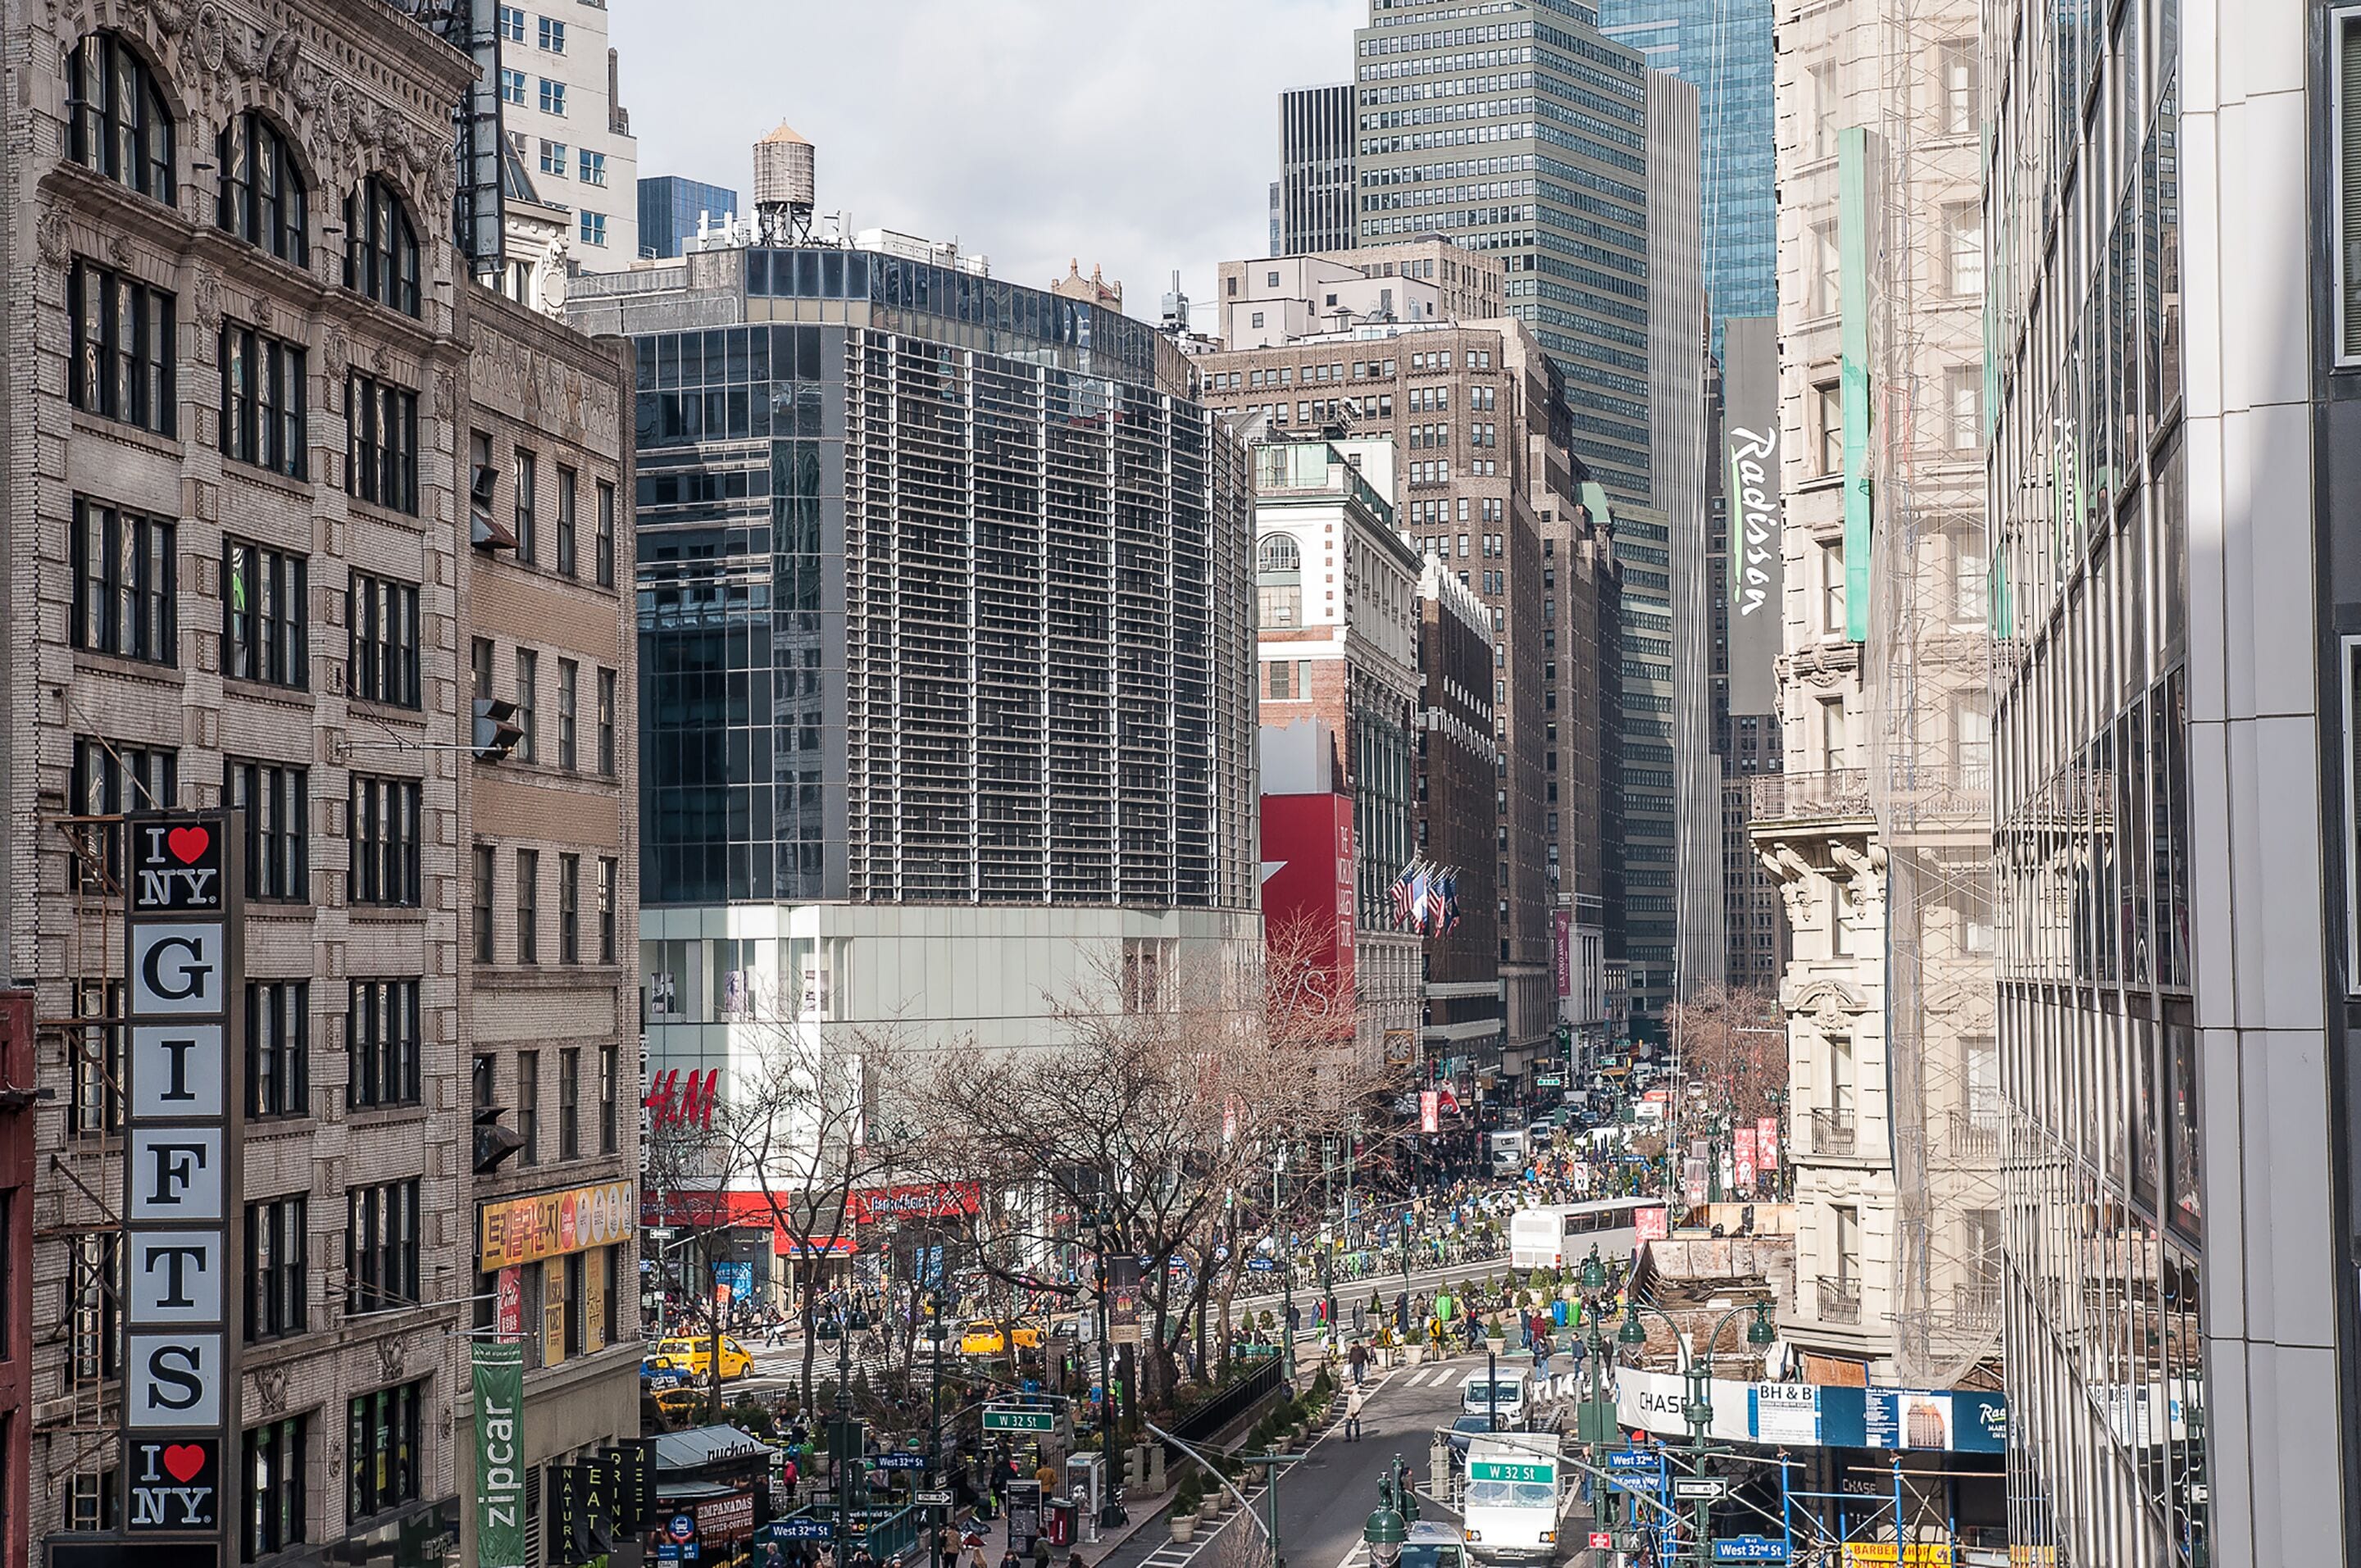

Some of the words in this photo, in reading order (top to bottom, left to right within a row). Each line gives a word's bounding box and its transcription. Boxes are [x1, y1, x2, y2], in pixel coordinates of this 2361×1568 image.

[1731, 426, 1779, 616] Radisson
[145, 828, 166, 864] I
[139, 869, 215, 905] NY
[143, 937, 213, 1411] GIFTS
[1760, 1385, 1781, 1398] BH
[1786, 1386, 1798, 1400] &
[1803, 1387, 1812, 1400] B
[999, 1416, 1009, 1426] W
[1012, 1416, 1023, 1426] 32
[1027, 1416, 1037, 1427] St
[707, 1440, 756, 1461] nuchas
[1613, 1456, 1635, 1465] West
[140, 1444, 161, 1481] I
[478, 1396, 522, 1528] zipcar
[879, 1457, 898, 1466] West
[899, 1457, 914, 1466] 32nd
[915, 1458, 924, 1467] St
[1490, 1466, 1500, 1478] W
[1505, 1466, 1518, 1479] 32
[1523, 1467, 1535, 1480] St
[1703, 1485, 1718, 1493] WAY
[1843, 1479, 1877, 1495] CHASE
[132, 1487, 212, 1525] NY
[587, 1468, 602, 1530] EAT
[698, 1498, 753, 1519] EMPANADAS
[562, 1469, 572, 1565] NATURAL
[773, 1526, 797, 1536] West
[798, 1525, 817, 1536] 32nd
[818, 1526, 829, 1536] St
[1721, 1544, 1747, 1557] West
[1749, 1544, 1768, 1556] 32nd
[1771, 1544, 1782, 1557] St
[1854, 1545, 1898, 1555] BARBER
